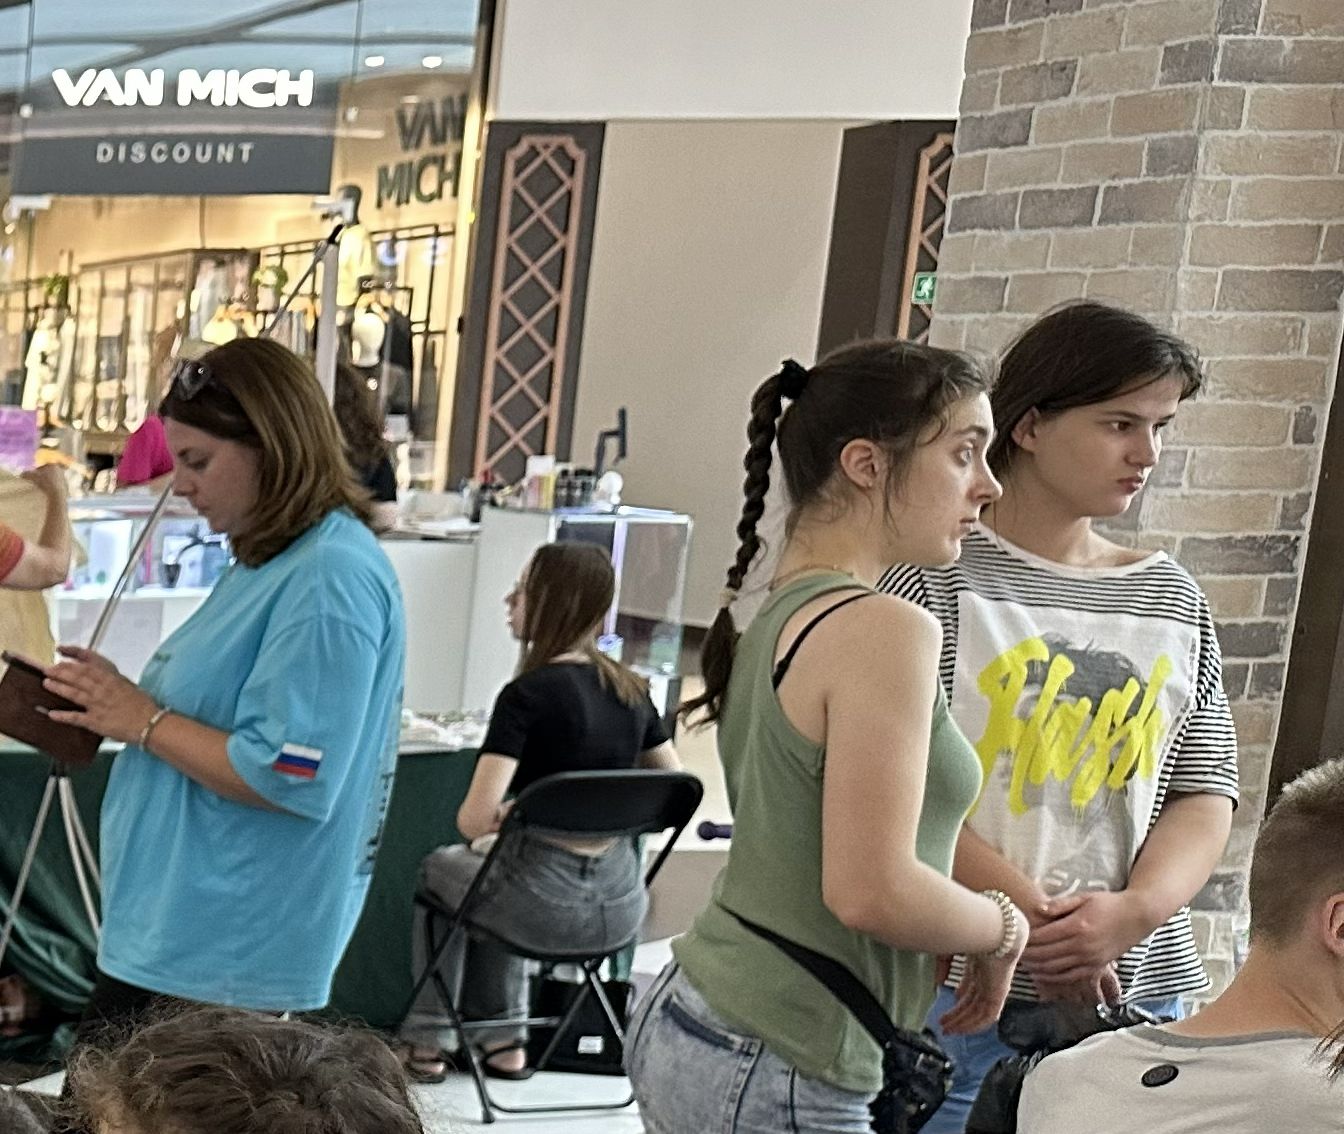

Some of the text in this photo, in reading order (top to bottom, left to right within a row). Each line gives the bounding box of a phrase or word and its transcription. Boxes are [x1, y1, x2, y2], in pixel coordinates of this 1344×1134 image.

[52, 68, 314, 107] VAN MICH
[96, 141, 254, 164] DISCOUNT
[376, 152, 463, 209] MICH
